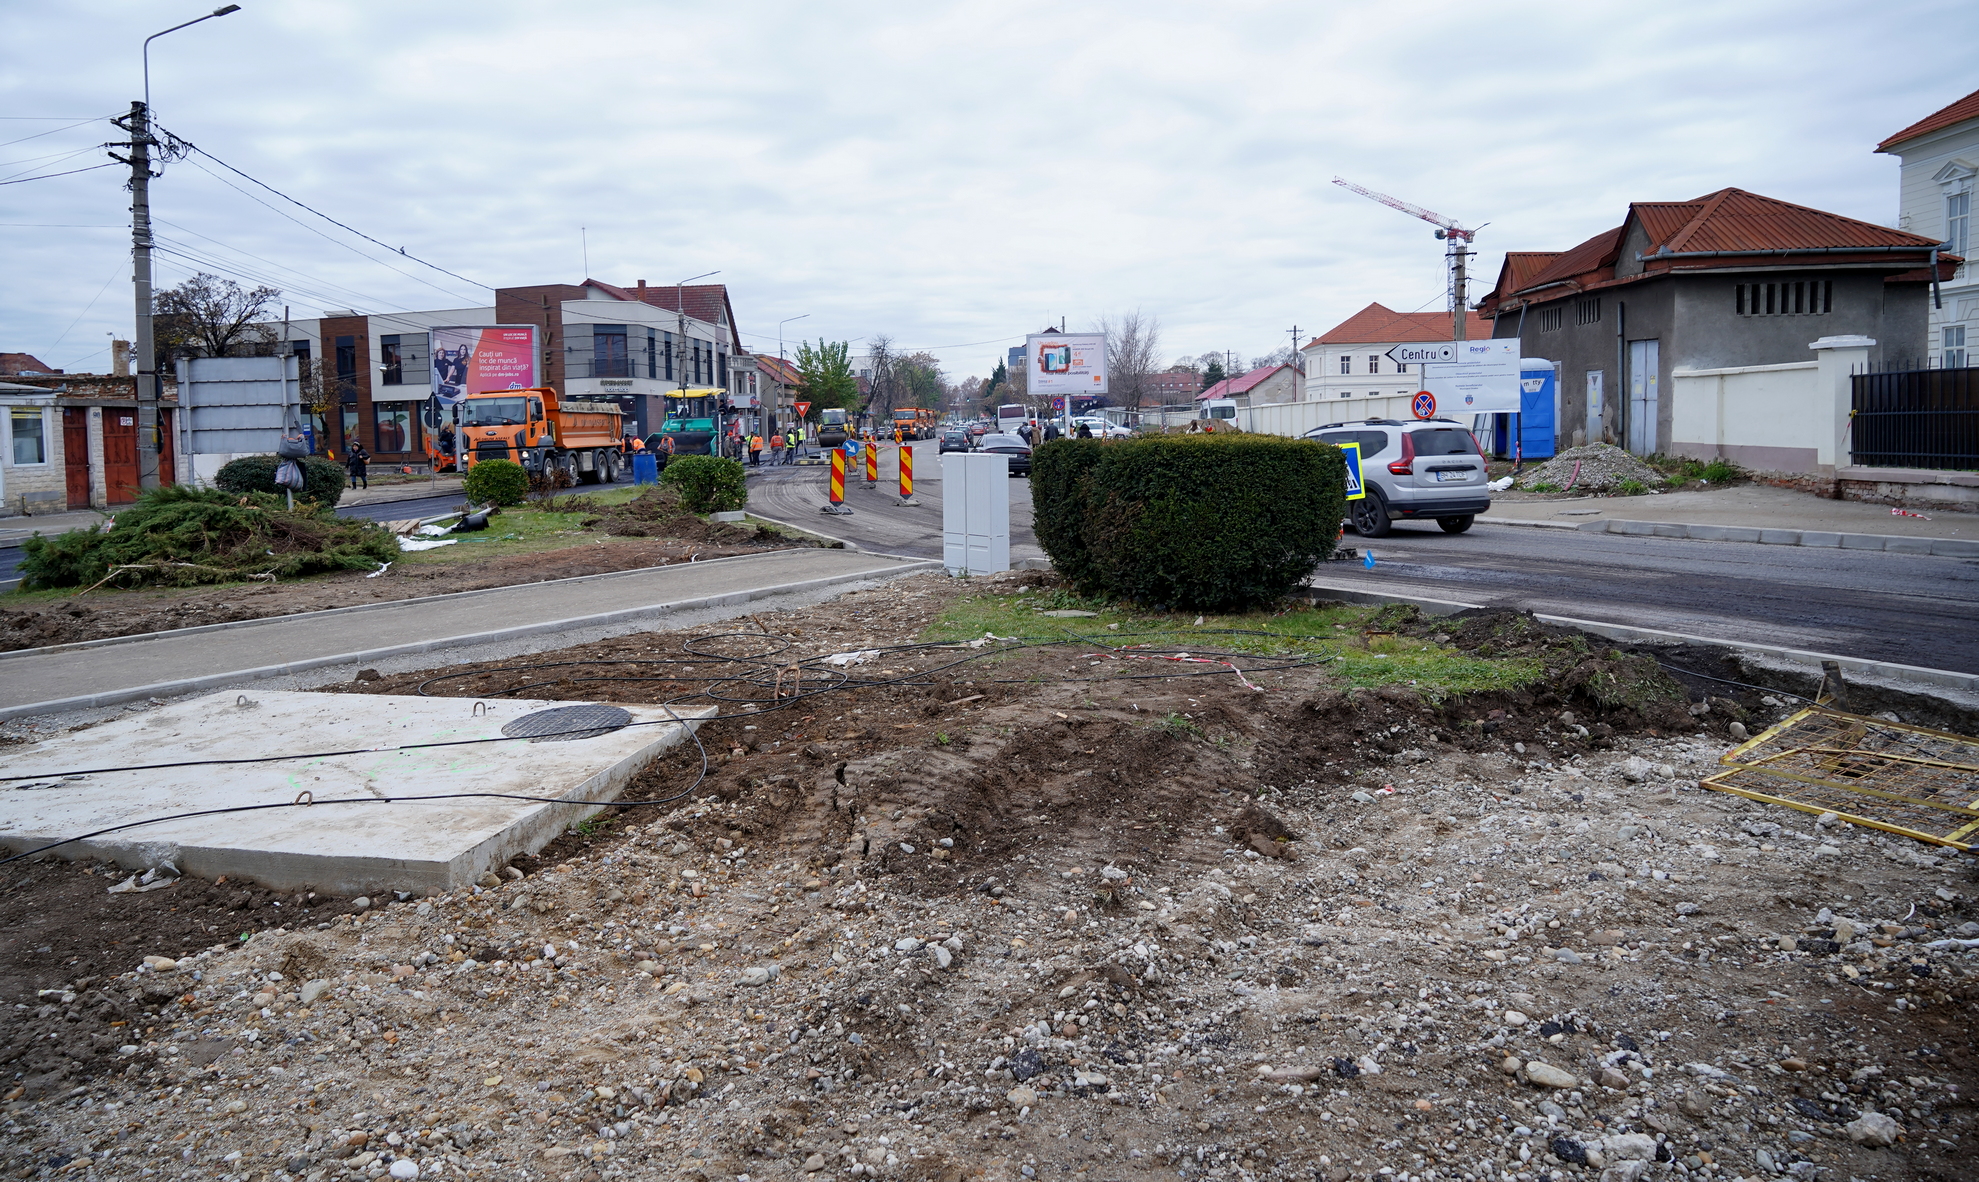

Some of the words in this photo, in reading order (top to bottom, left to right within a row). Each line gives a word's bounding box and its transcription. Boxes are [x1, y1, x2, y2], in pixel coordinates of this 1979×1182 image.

[1401, 348, 1436, 360] Centru
[1469, 346, 1490, 354] Regio
[509, 382, 521, 390] dm
